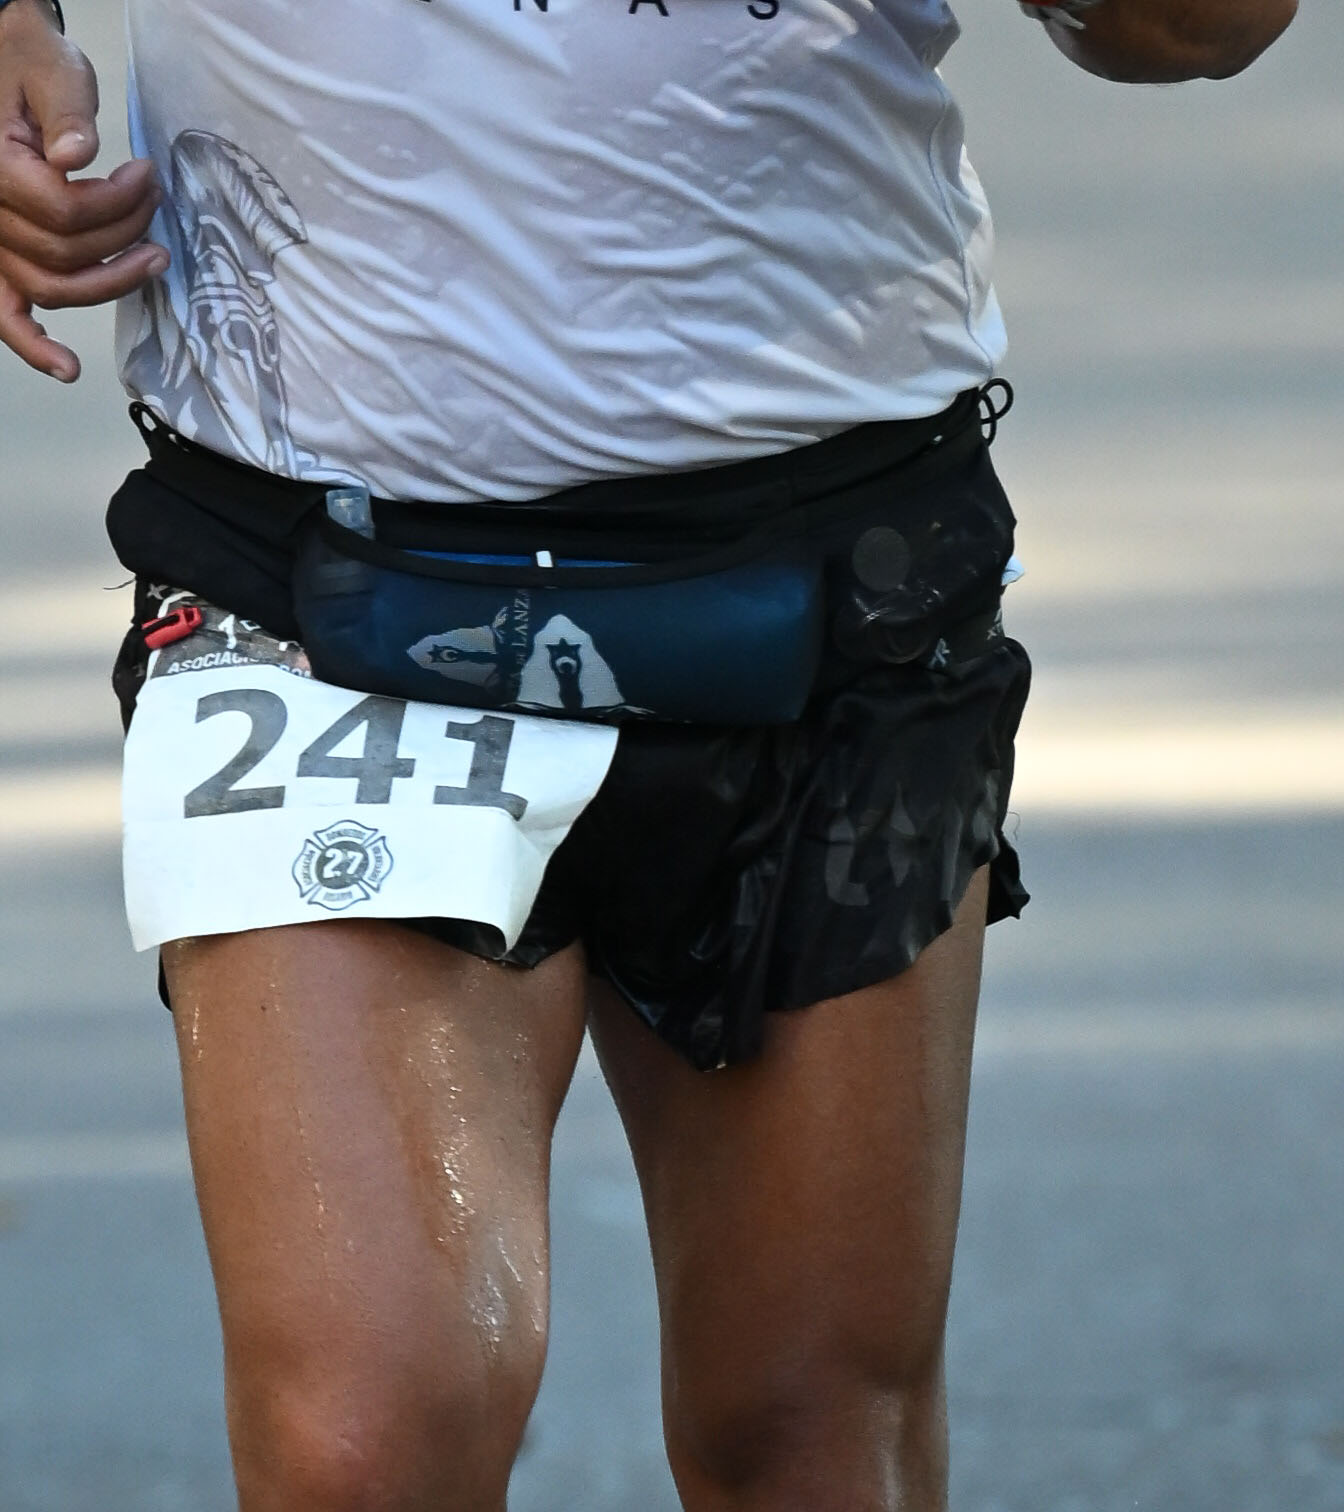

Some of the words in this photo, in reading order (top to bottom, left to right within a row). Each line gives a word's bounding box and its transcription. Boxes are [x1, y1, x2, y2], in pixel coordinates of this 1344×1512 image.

[167, 651, 260, 675] ASOCIAC
[184, 688, 529, 822] 241
[323, 847, 364, 879] 27
